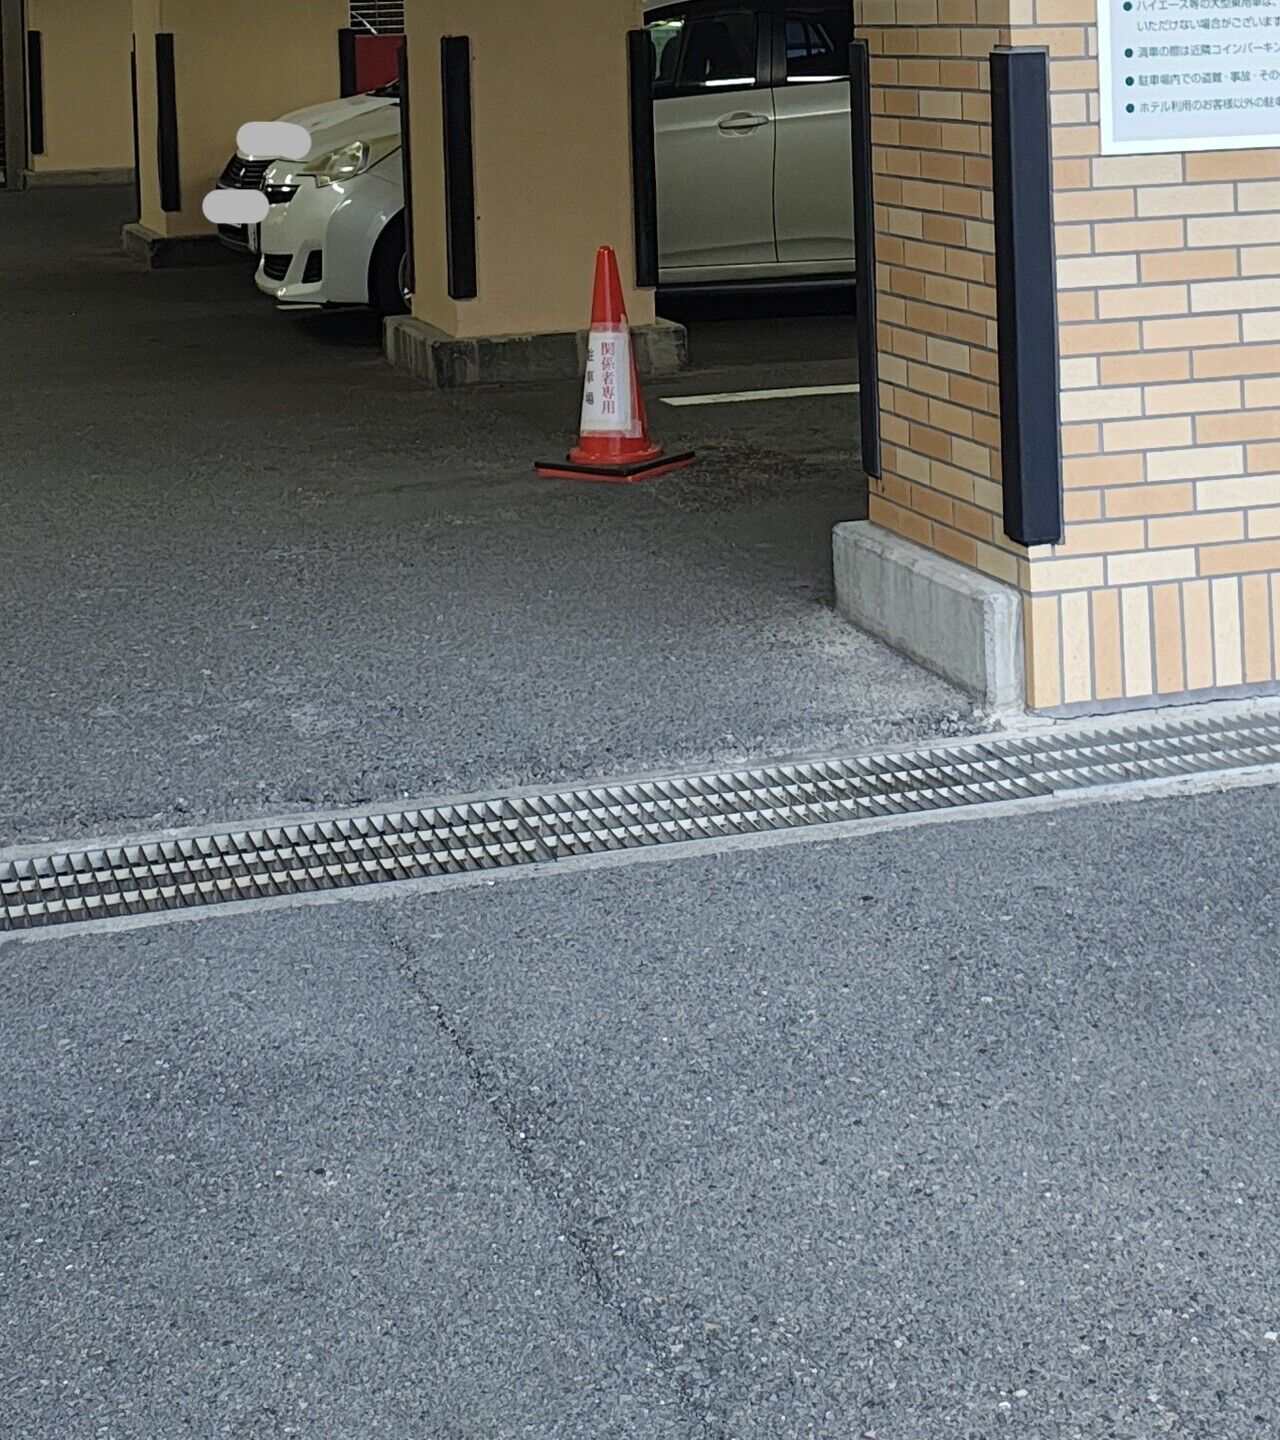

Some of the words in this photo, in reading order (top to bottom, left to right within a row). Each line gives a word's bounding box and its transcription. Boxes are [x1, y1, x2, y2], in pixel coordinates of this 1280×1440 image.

[601, 342, 615, 414] 関係者専用
